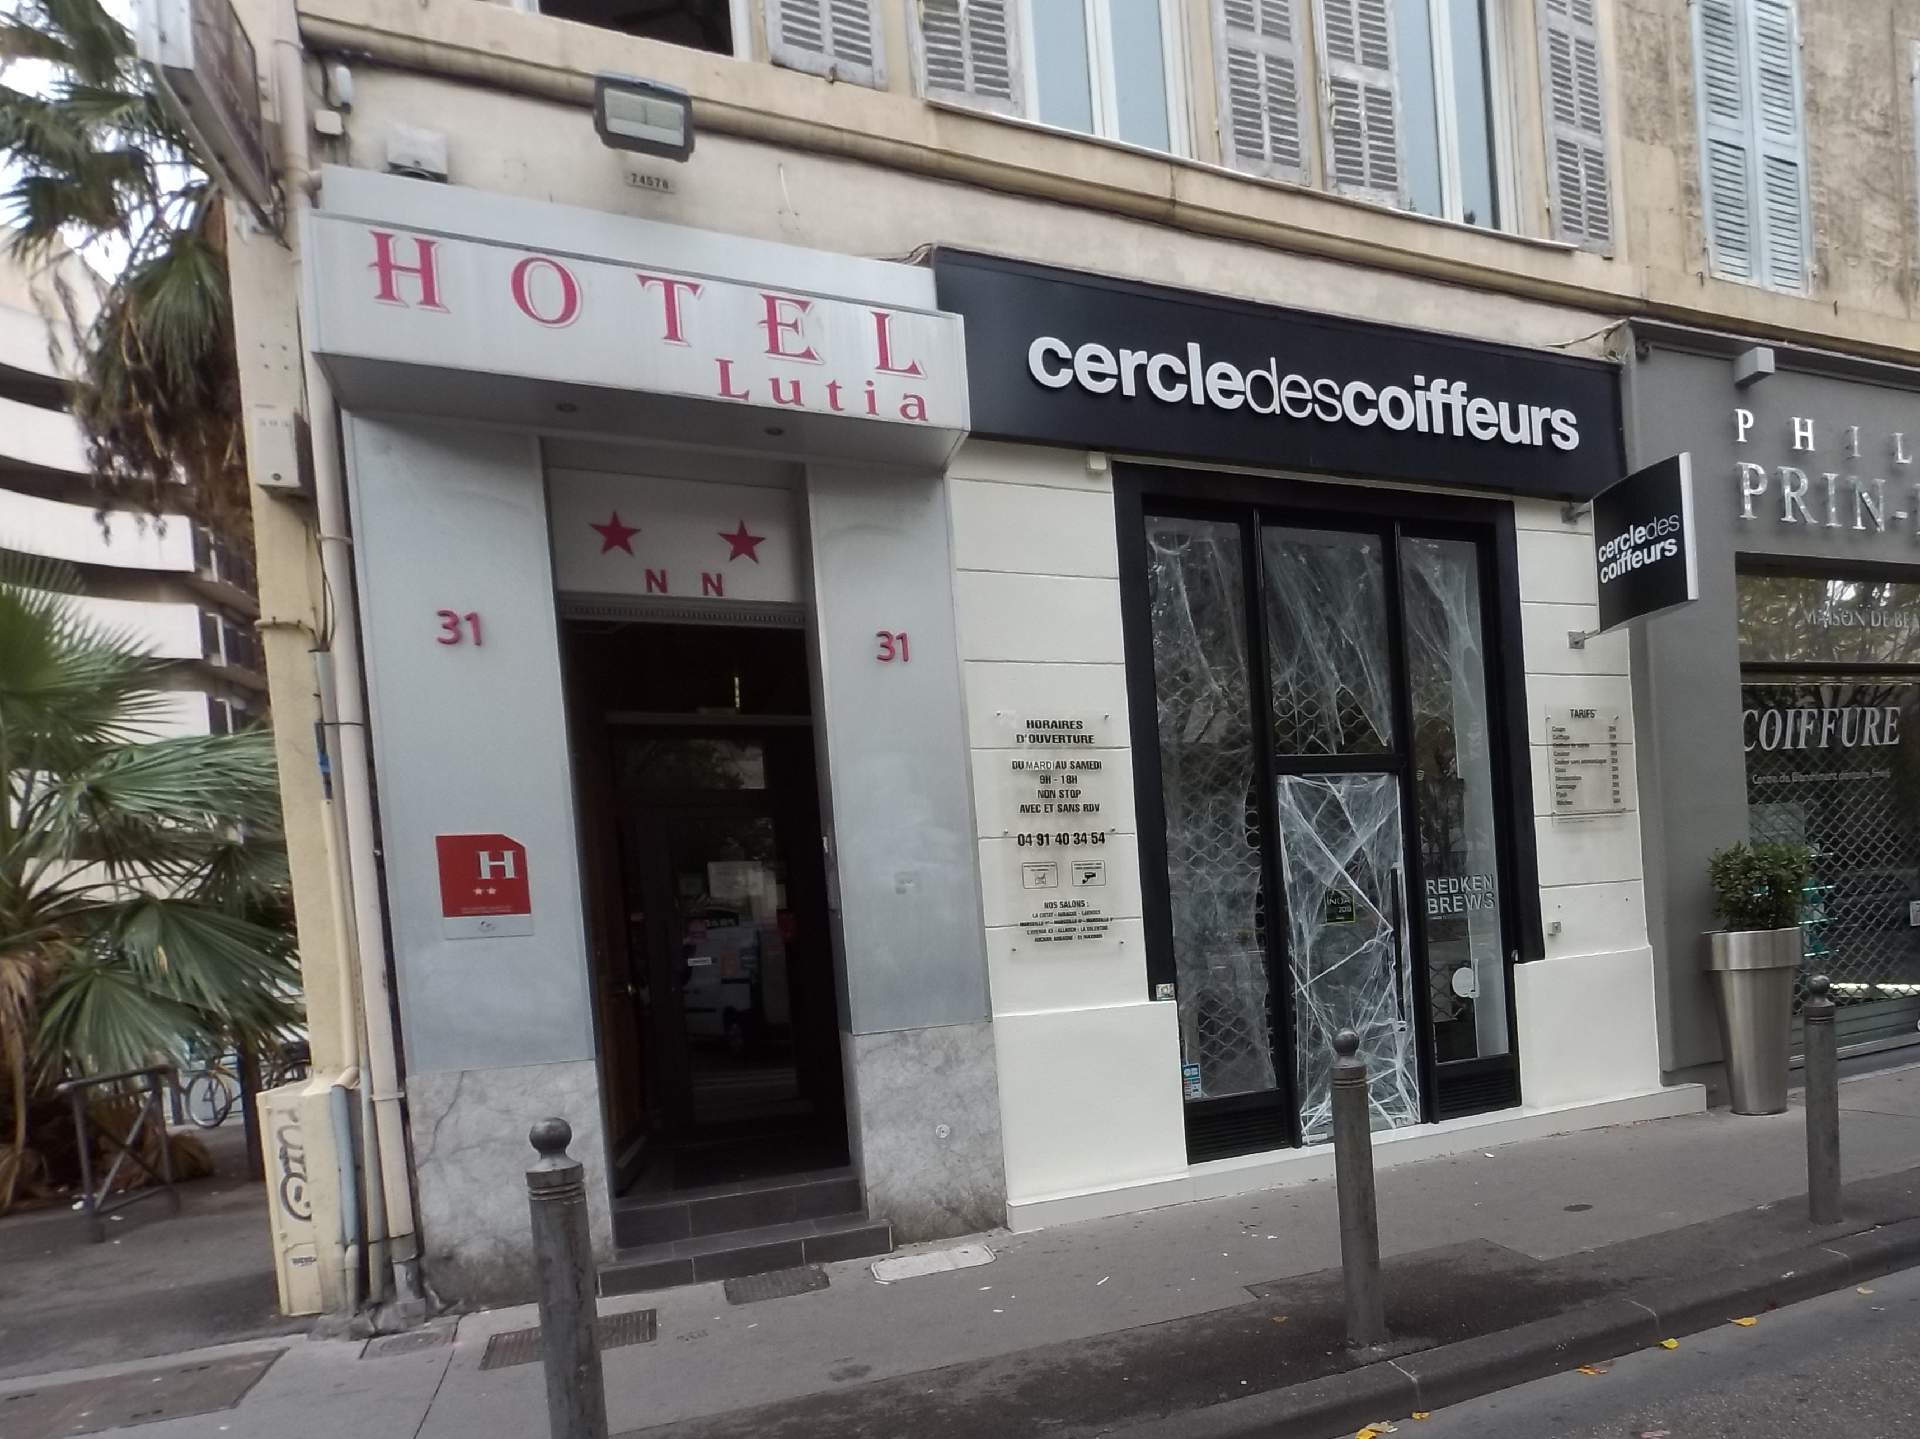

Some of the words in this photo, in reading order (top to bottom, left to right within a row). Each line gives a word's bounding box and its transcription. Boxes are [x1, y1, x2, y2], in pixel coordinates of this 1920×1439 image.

[368, 228, 928, 378] HOTEL
[715, 358, 928, 421] Lutia
[1028, 336, 1580, 451] cercledescoiffeurs
[1736, 462, 1920, 536] PRIN-
[1598, 514, 1680, 563] cercledes
[1600, 538, 1678, 583] coiffeurs
[436, 610, 482, 647] 31
[1870, 610, 1889, 628] DE
[876, 631, 910, 662] 31
[1570, 708, 1595, 719] TARIFS
[1026, 720, 1084, 730] HORAIRES
[1743, 706, 1901, 752] COIFFURE
[1016, 734, 1095, 744] D'OUVERTURE
[1012, 761, 1024, 770] DU
[1025, 761, 1055, 771] MARDI
[1055, 761, 1067, 770] AU
[1070, 760, 1102, 770] SAMEDI
[1039, 775, 1051, 785] 9H
[1061, 775, 1078, 785] 18H
[1037, 790, 1056, 799] NON
[1059, 790, 1081, 799] STOP
[1020, 804, 1041, 814] AVEC
[1044, 804, 1053, 813] ET
[1057, 804, 1081, 813] SANS
[1083, 803, 1100, 813] RDV
[1017, 833, 1032, 846] 04
[1036, 833, 1050, 846] 91
[1055, 833, 1069, 846] 40
[1073, 833, 1088, 845] 34
[1091, 832, 1105, 845] 54
[477, 850, 516, 880] H
[1426, 874, 1494, 895] REDKEN
[1044, 901, 1058, 909] NOS
[1059, 900, 1086, 909] SALONS
[1427, 892, 1496, 914] BREWS
